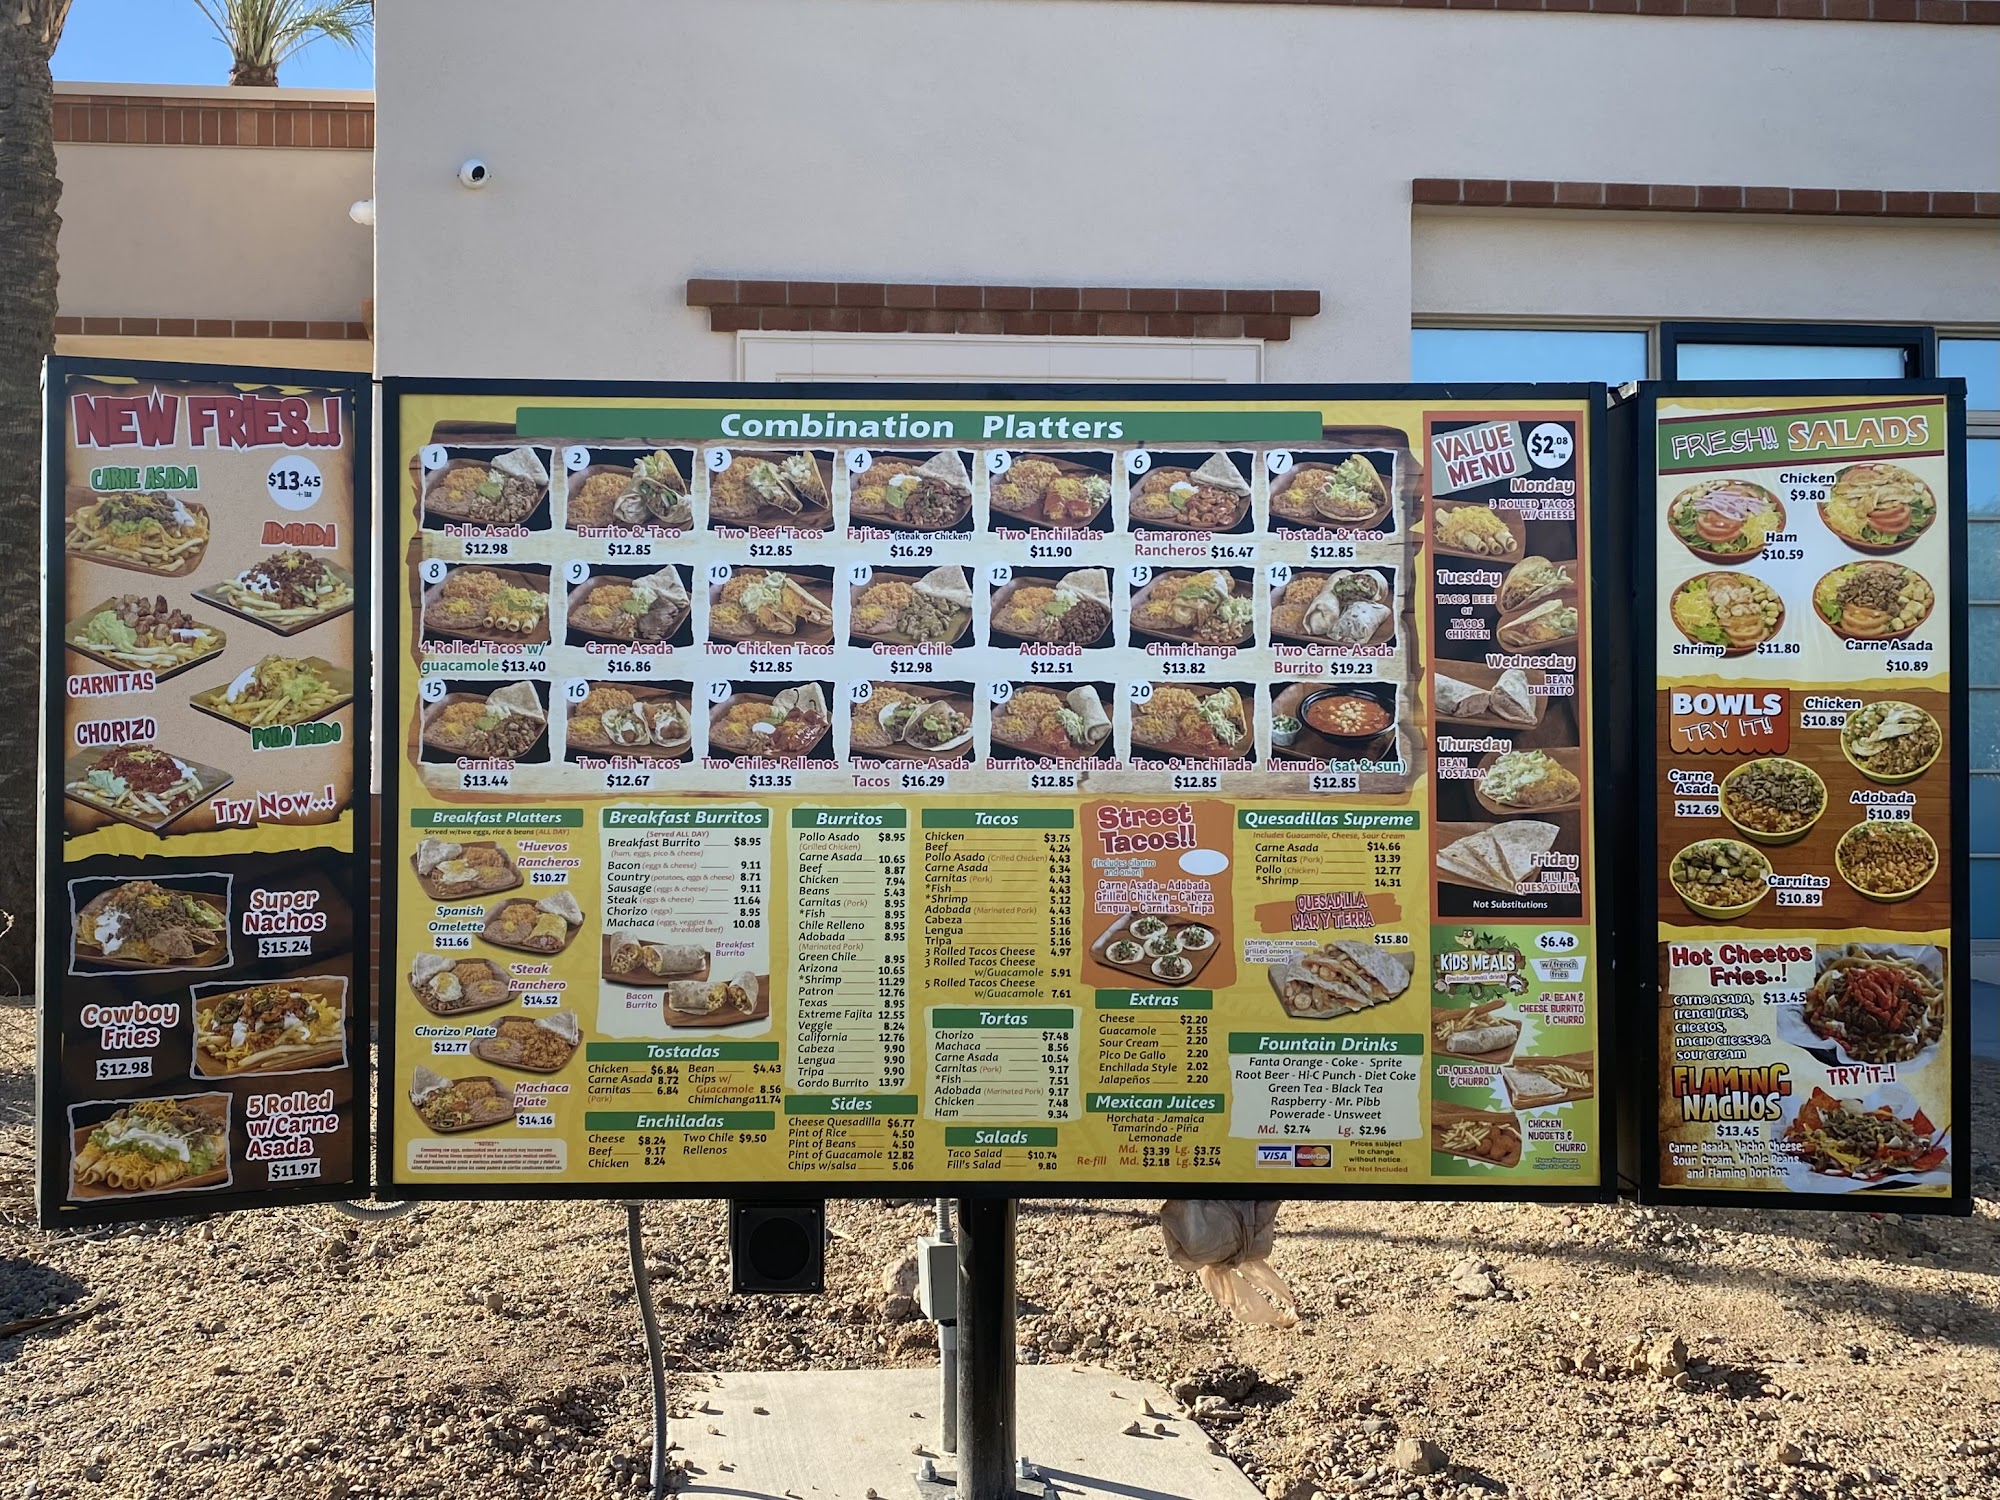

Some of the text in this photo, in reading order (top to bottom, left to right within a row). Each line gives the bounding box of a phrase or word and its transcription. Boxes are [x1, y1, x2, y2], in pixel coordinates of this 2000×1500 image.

[71, 385, 181, 449] NEW
[720, 413, 1123, 440] Combination Platters
[1435, 424, 1513, 463] VALUE
[1531, 434, 1568, 456] $2.08
[1671, 416, 1928, 460] FRESH!! SALADS
[432, 451, 439, 464] 1
[854, 456, 863, 468] 4
[1447, 450, 1516, 487] MENU
[90, 466, 199, 490] CARNE ASADA
[268, 470, 321, 491] $13.45
[1780, 472, 1835, 484] Chicken
[1511, 478, 1575, 494] Monday
[1790, 490, 1826, 500] $9.80
[1489, 500, 1574, 509] 3 ROLLED TACOS
[1522, 510, 1575, 520] W/CHEESE
[260, 521, 336, 548] ADOBADA
[445, 524, 528, 539] Pollo Asado
[578, 524, 681, 540] Burrito & Taco
[846, 527, 890, 542] Fajitas
[895, 532, 921, 542] (steak
[935, 532, 972, 542] Chicken)
[465, 543, 508, 556] $12.98
[608, 544, 651, 557] $12.85
[890, 545, 933, 558] $16.29
[1438, 570, 1501, 586] Tuesday
[421, 641, 545, 656] 4 Rolled Tacos w/
[1146, 643, 1237, 659] Chimichanga
[1672, 643, 1800, 657] Shrimp $11.80
[1845, 640, 1933, 651] Carne Asada
[421, 659, 546, 675] guacamole $13.40
[1162, 662, 1206, 674] $13.82
[1486, 654, 1575, 671] Wednesday
[1886, 660, 1928, 672] $10.89
[68, 672, 155, 696] CARNITAS
[1673, 694, 1782, 715] BOWLS
[76, 718, 155, 744] CHORIZO
[1680, 721, 1729, 742] TRY
[1438, 738, 1512, 754] Thursday
[702, 756, 839, 770] Two Chiles Rellenos
[1267, 758, 1406, 774] Menudo (sat & sun)
[749, 773, 792, 788] $13.35
[1313, 776, 1356, 789] $12.85
[1850, 791, 1915, 804] Adobada
[211, 799, 255, 824] Try
[432, 812, 562, 824] Breakfast Platters
[609, 811, 762, 826] Breakfast Burritos
[816, 812, 883, 825] Burritos
[975, 812, 1018, 825] Tacos
[1098, 804, 1192, 829] Street
[1868, 809, 1910, 820] $10.89
[1245, 813, 1413, 828] Quesadillas Supreme
[1100, 825, 1196, 853] Tacos!!
[518, 858, 579, 867] Rancheros
[607, 861, 761, 870] Bacon 9.11
[1255, 854, 1400, 864] Carnitas (Pork) 13.39
[1530, 853, 1578, 868] Friday
[532, 873, 566, 882] $10.27
[1049, 886, 1070, 894] 4.43
[251, 890, 318, 913] Super
[1473, 900, 1548, 909] Not Substitutions
[244, 912, 325, 934] Nachos
[1374, 935, 1408, 945] $15.80
[1540, 936, 1574, 948] $6.48
[261, 940, 309, 955] $15.24
[1672, 944, 1812, 966] Hot Cheetos
[798, 965, 905, 975] Arizona 10.65
[1129, 993, 1179, 1006] Extras
[1763, 992, 1806, 1004] $13.45
[82, 1003, 179, 1028] Cowboy
[980, 1012, 1028, 1025] Tortas
[415, 1027, 496, 1036] Chorizo Plate
[1099, 1026, 1208, 1035] Guacamole 2.55
[102, 1028, 159, 1049] Fries
[1259, 1037, 1398, 1051] Fountain Drinks
[434, 1043, 467, 1052] $12.77
[647, 1045, 720, 1058] Tostadas
[100, 1062, 149, 1077] $12.98
[588, 1065, 679, 1075] Chicken $6.84
[1672, 1063, 1792, 1097] FLAMING
[248, 1090, 332, 1116] 5 Rolled
[831, 1098, 872, 1110] Sides
[1096, 1096, 1215, 1109] Mexican Juices
[1682, 1092, 1782, 1122] NACHOS
[247, 1113, 337, 1137] w/Carne
[637, 1115, 724, 1128] Enchiladas
[789, 1118, 915, 1128] Cheese Quesadilla $6.77
[975, 1131, 1028, 1144] Salads
[1258, 1125, 1386, 1137] Md. $2.74 Lg. $2.96
[1717, 1126, 1760, 1137] $13.45
[248, 1137, 312, 1160] Asada
[947, 1149, 1057, 1160] Taco Salad $10.74
[1555, 1143, 1586, 1152] CHURRO
[1263, 1152, 1287, 1160] VISA
[272, 1162, 317, 1178] $11.97
